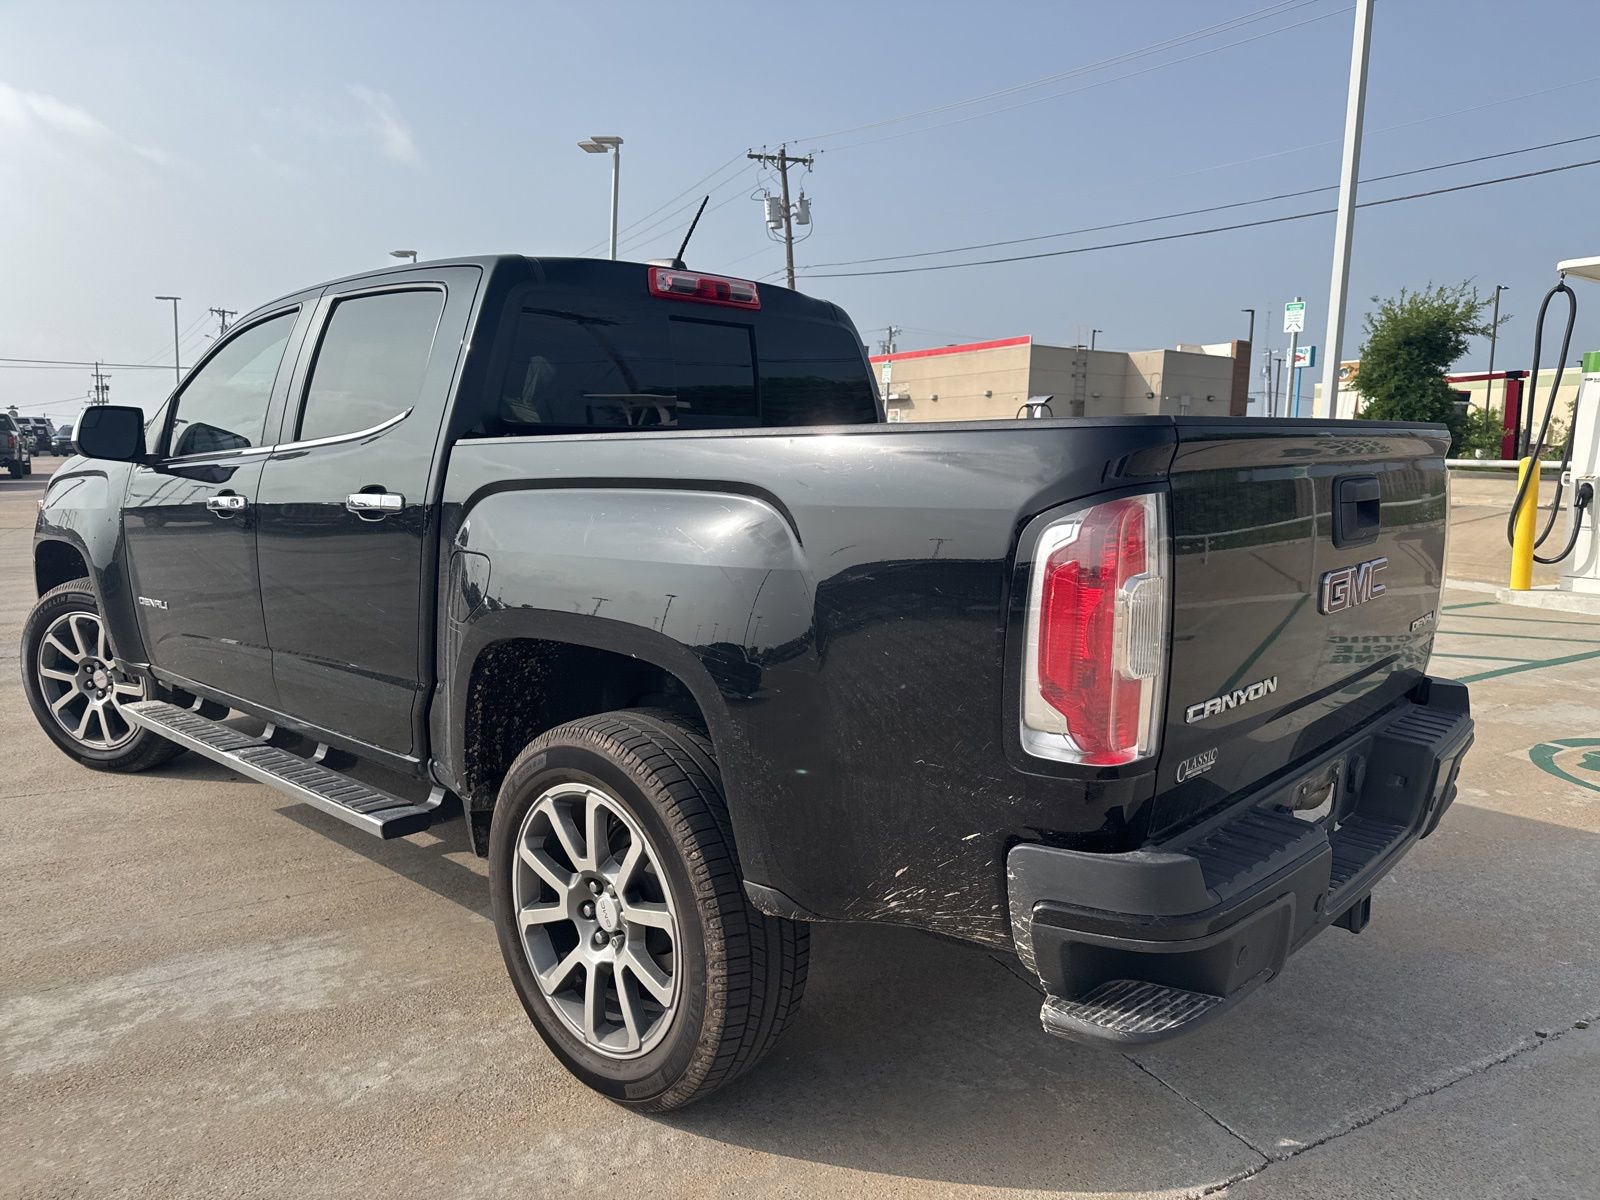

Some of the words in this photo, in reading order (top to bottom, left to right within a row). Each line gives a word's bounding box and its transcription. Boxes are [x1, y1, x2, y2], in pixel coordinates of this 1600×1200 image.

[138, 596, 169, 610] DENALI
[1318, 556, 1388, 615] GMC
[1185, 676, 1278, 724] CANYON
[1176, 747, 1219, 783] CLASSIC
